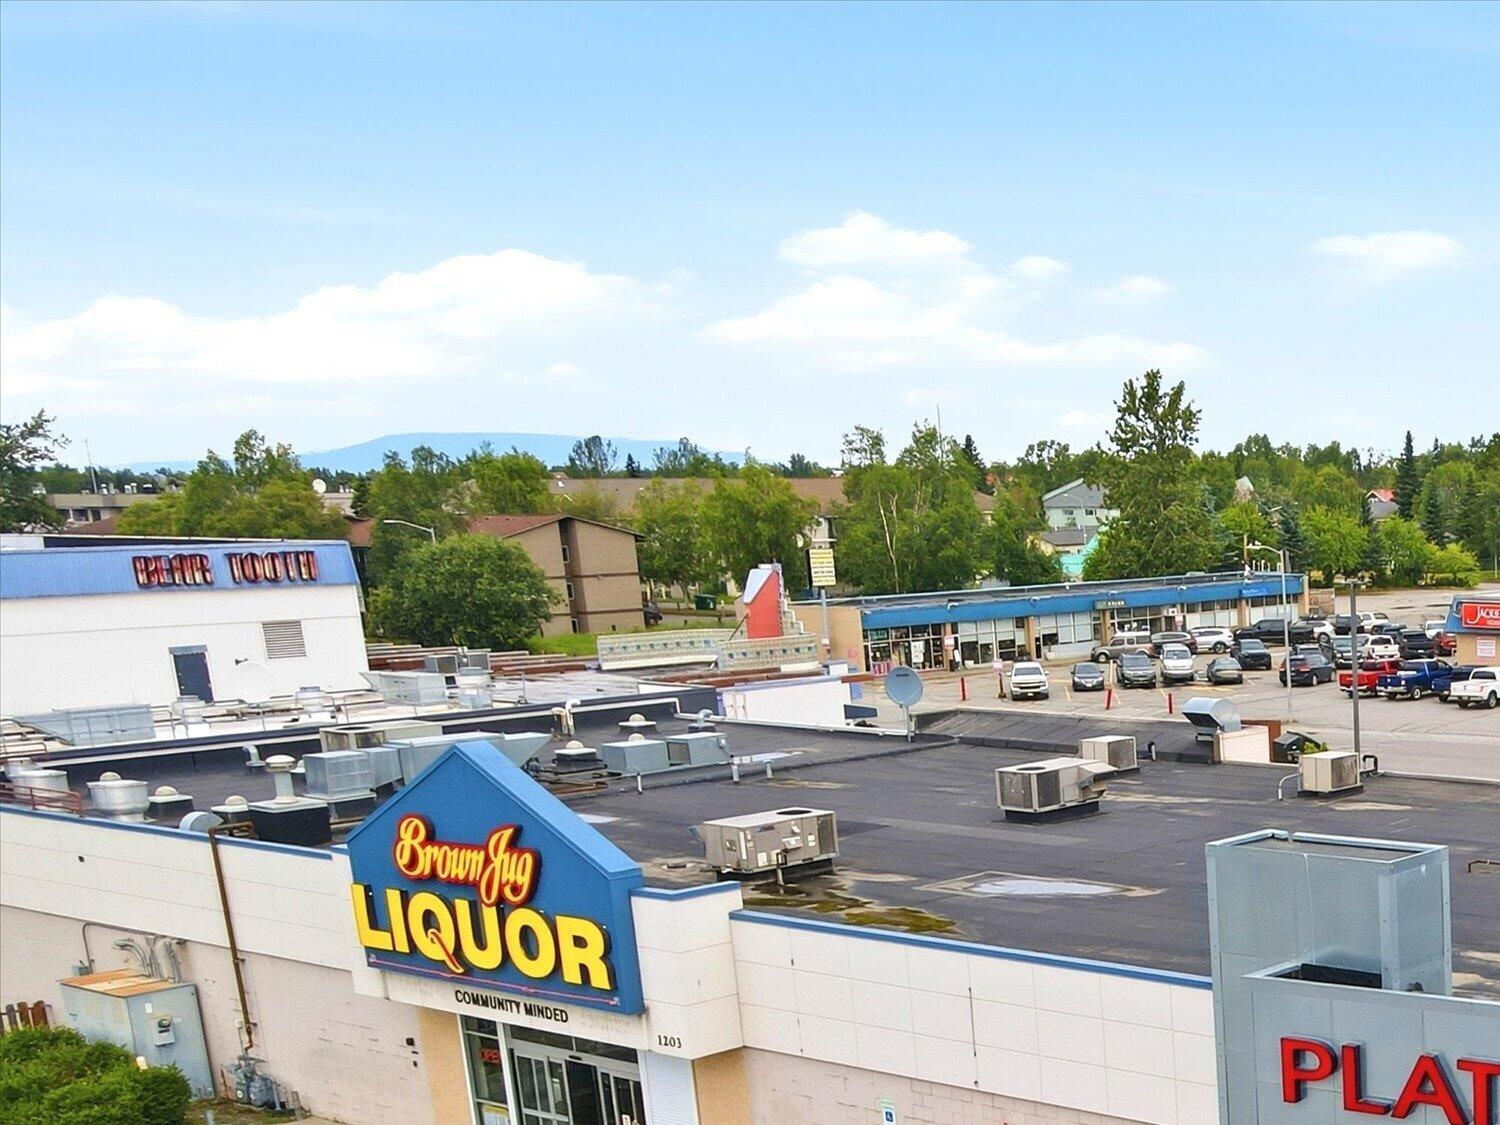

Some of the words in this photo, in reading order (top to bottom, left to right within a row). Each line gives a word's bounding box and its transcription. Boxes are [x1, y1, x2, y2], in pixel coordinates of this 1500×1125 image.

[132, 553, 214, 589] BEAR
[225, 550, 320, 584] TOOTH
[394, 814, 488, 880] Brown
[478, 824, 537, 907] Jug
[351, 883, 614, 991] LIQUOR
[454, 989, 521, 1014] COMMUNITY
[523, 1003, 569, 1023] MINDED
[657, 1034, 682, 1049] 1203
